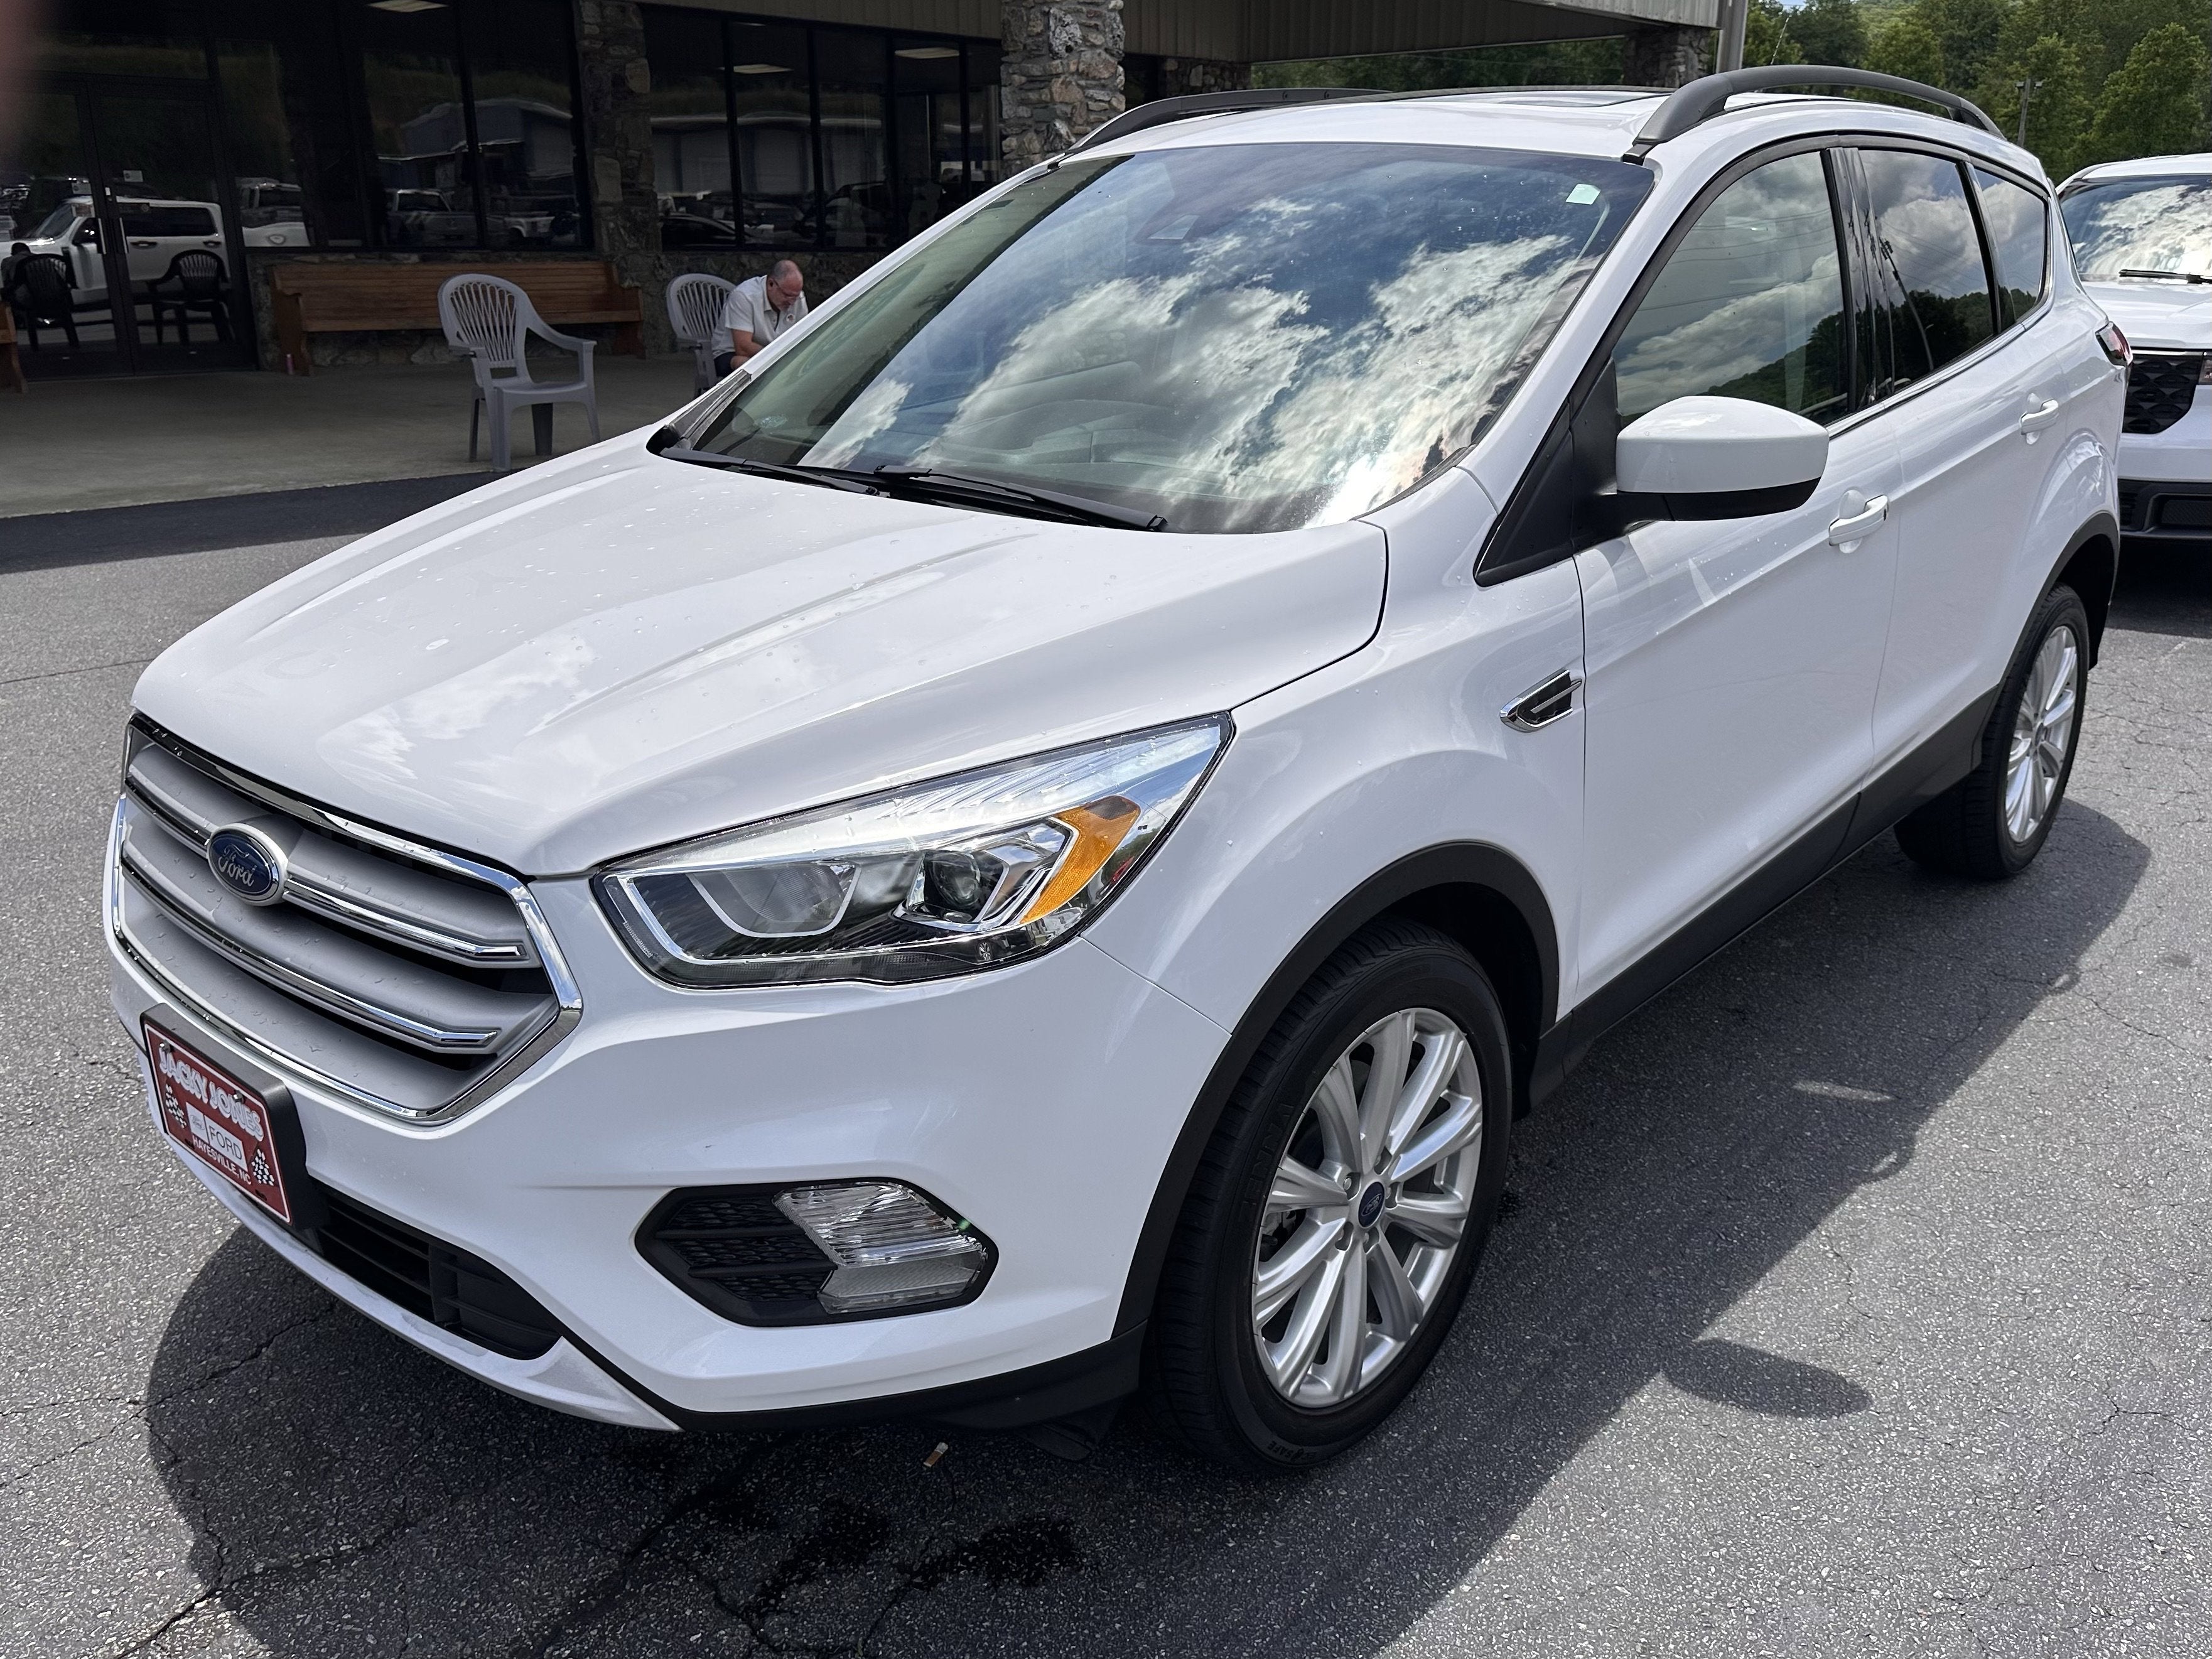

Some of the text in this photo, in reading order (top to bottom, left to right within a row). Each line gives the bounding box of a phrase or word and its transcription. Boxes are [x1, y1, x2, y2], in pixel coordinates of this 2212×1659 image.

[218, 844, 257, 886] Ford
[159, 1047, 264, 1142] JACKY JONES
[209, 1125, 242, 1160] FORD
[239, 1168, 251, 1185] NC
